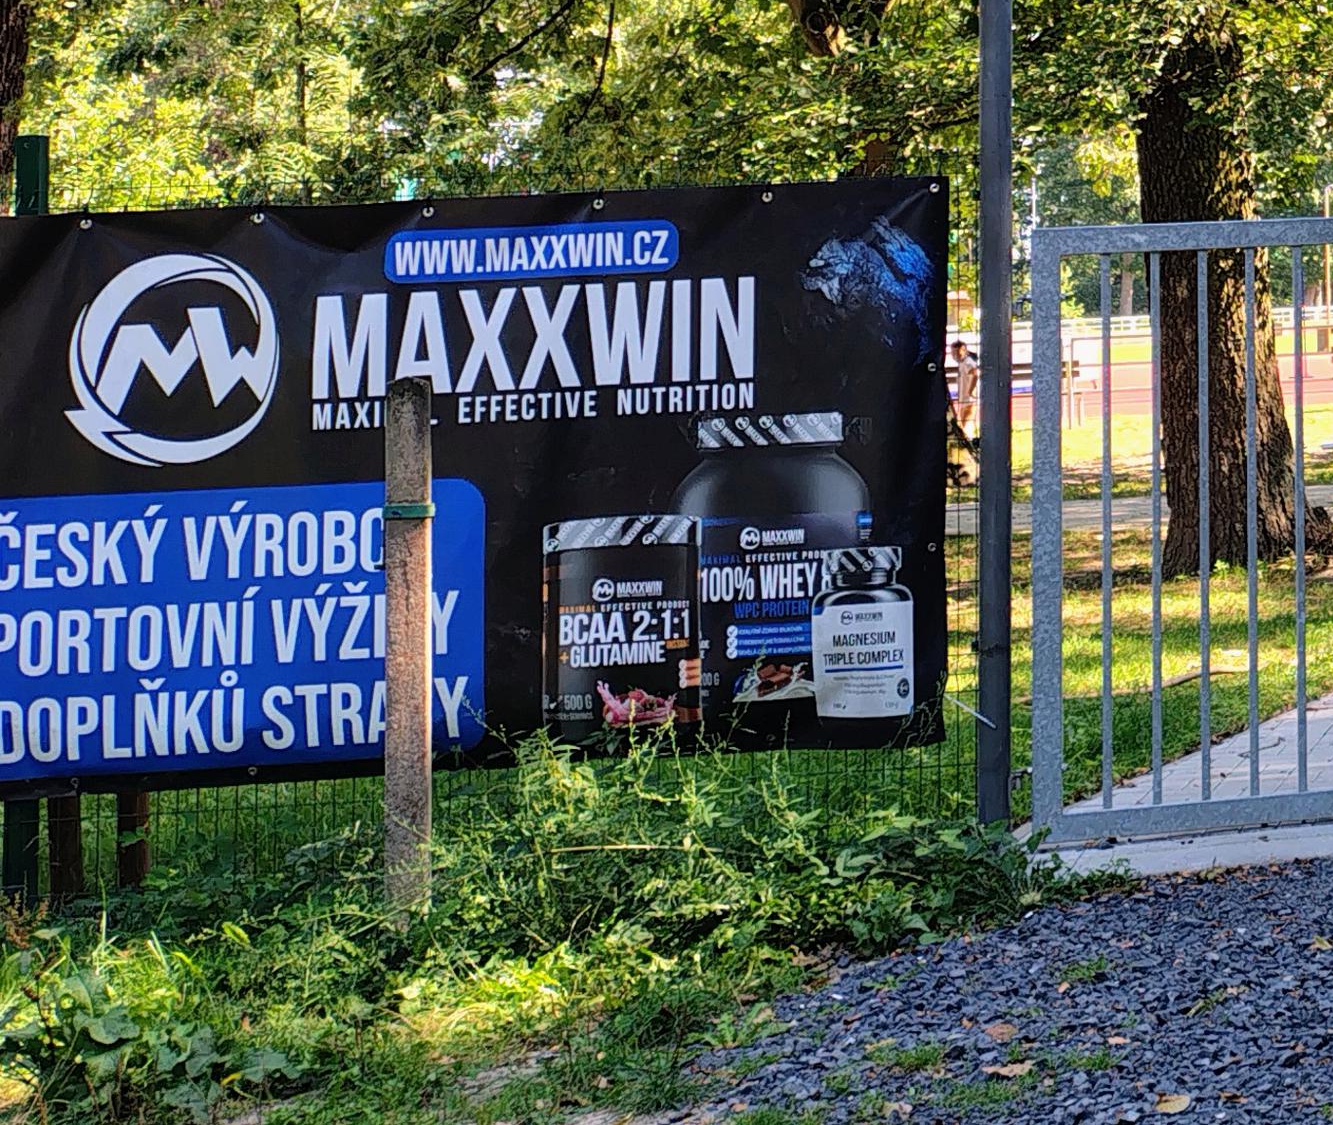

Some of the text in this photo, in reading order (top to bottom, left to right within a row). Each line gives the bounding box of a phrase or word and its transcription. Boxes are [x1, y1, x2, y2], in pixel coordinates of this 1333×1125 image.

[394, 230, 670, 275] WWW.MAXXWIN.CZ
[311, 276, 756, 399] MAXXWIN
[458, 390, 598, 424] EFFECTIVE
[617, 382, 755, 416] NUTRITION
[0, 504, 168, 590] ČESKÝ
[745, 551, 798, 563] EFFECTIVE
[701, 565, 755, 603] 100%
[760, 562, 818, 600] WHEY
[271, 581, 459, 664] VÝŽIY
[558, 608, 690, 646] BCAA 2:1:1
[600, 602, 653, 613] EFFECTIVE
[734, 600, 810, 618] WPC PROTEIN
[823, 649, 904, 667] TRIPLE COMPLEX
[832, 631, 896, 648] MAGNESIUM
[0, 670, 244, 764] DOPLŇKŮ
